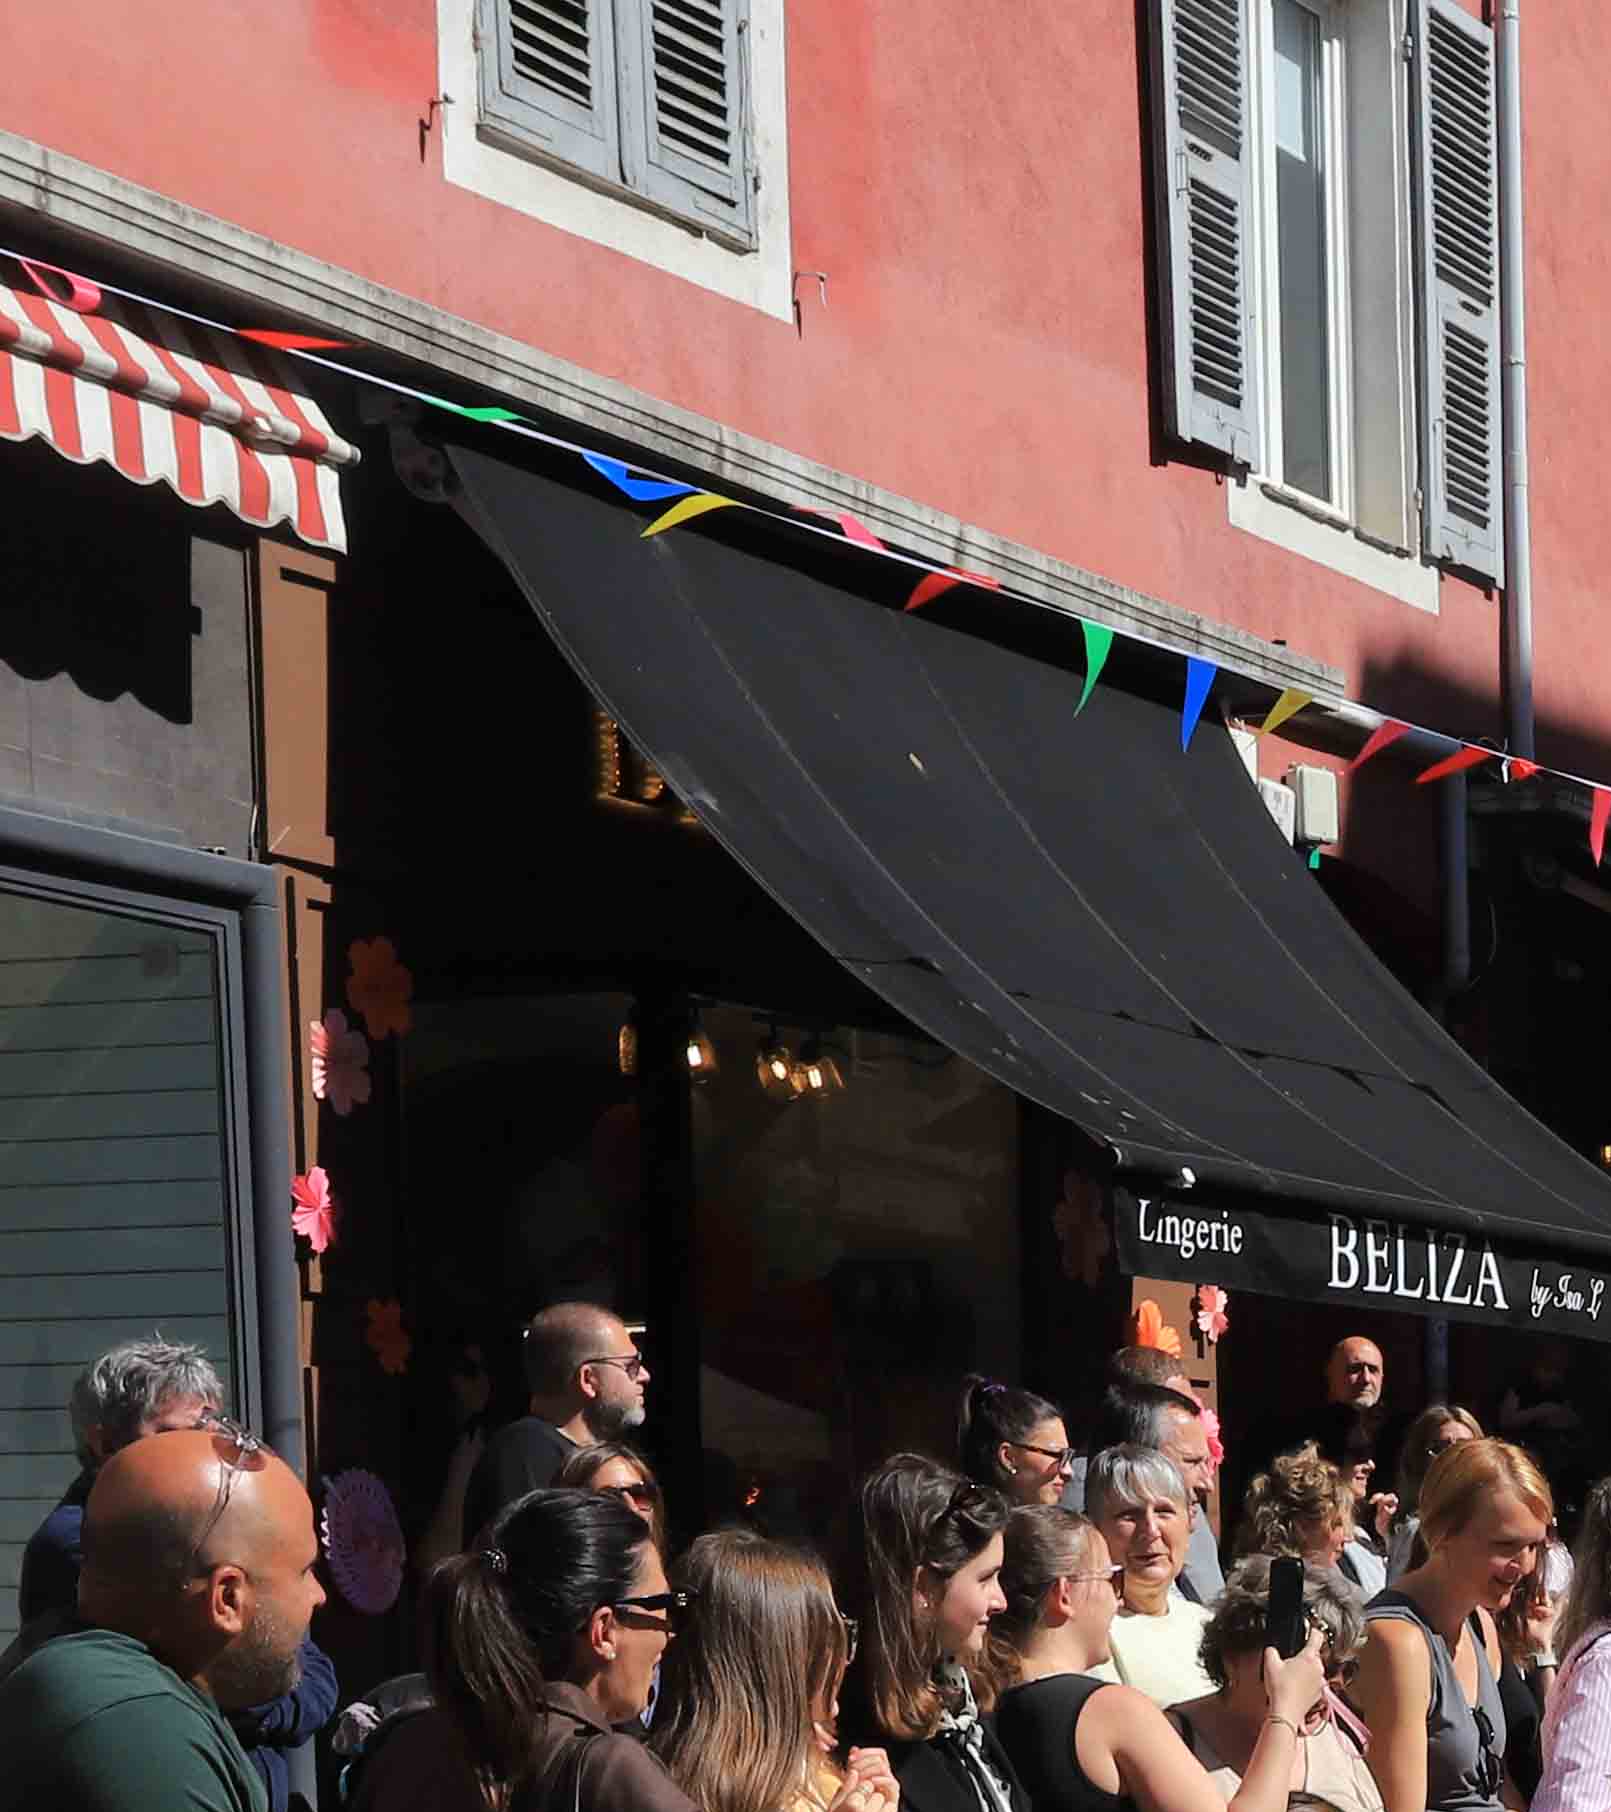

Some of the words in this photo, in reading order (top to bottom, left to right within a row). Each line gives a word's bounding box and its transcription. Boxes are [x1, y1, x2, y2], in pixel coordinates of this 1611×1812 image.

[1138, 1199, 1242, 1258] Lingerie
[1328, 1211, 1511, 1311] BELIZA
[1530, 1267, 1551, 1318] by
[1553, 1273, 1585, 1312] Isa
